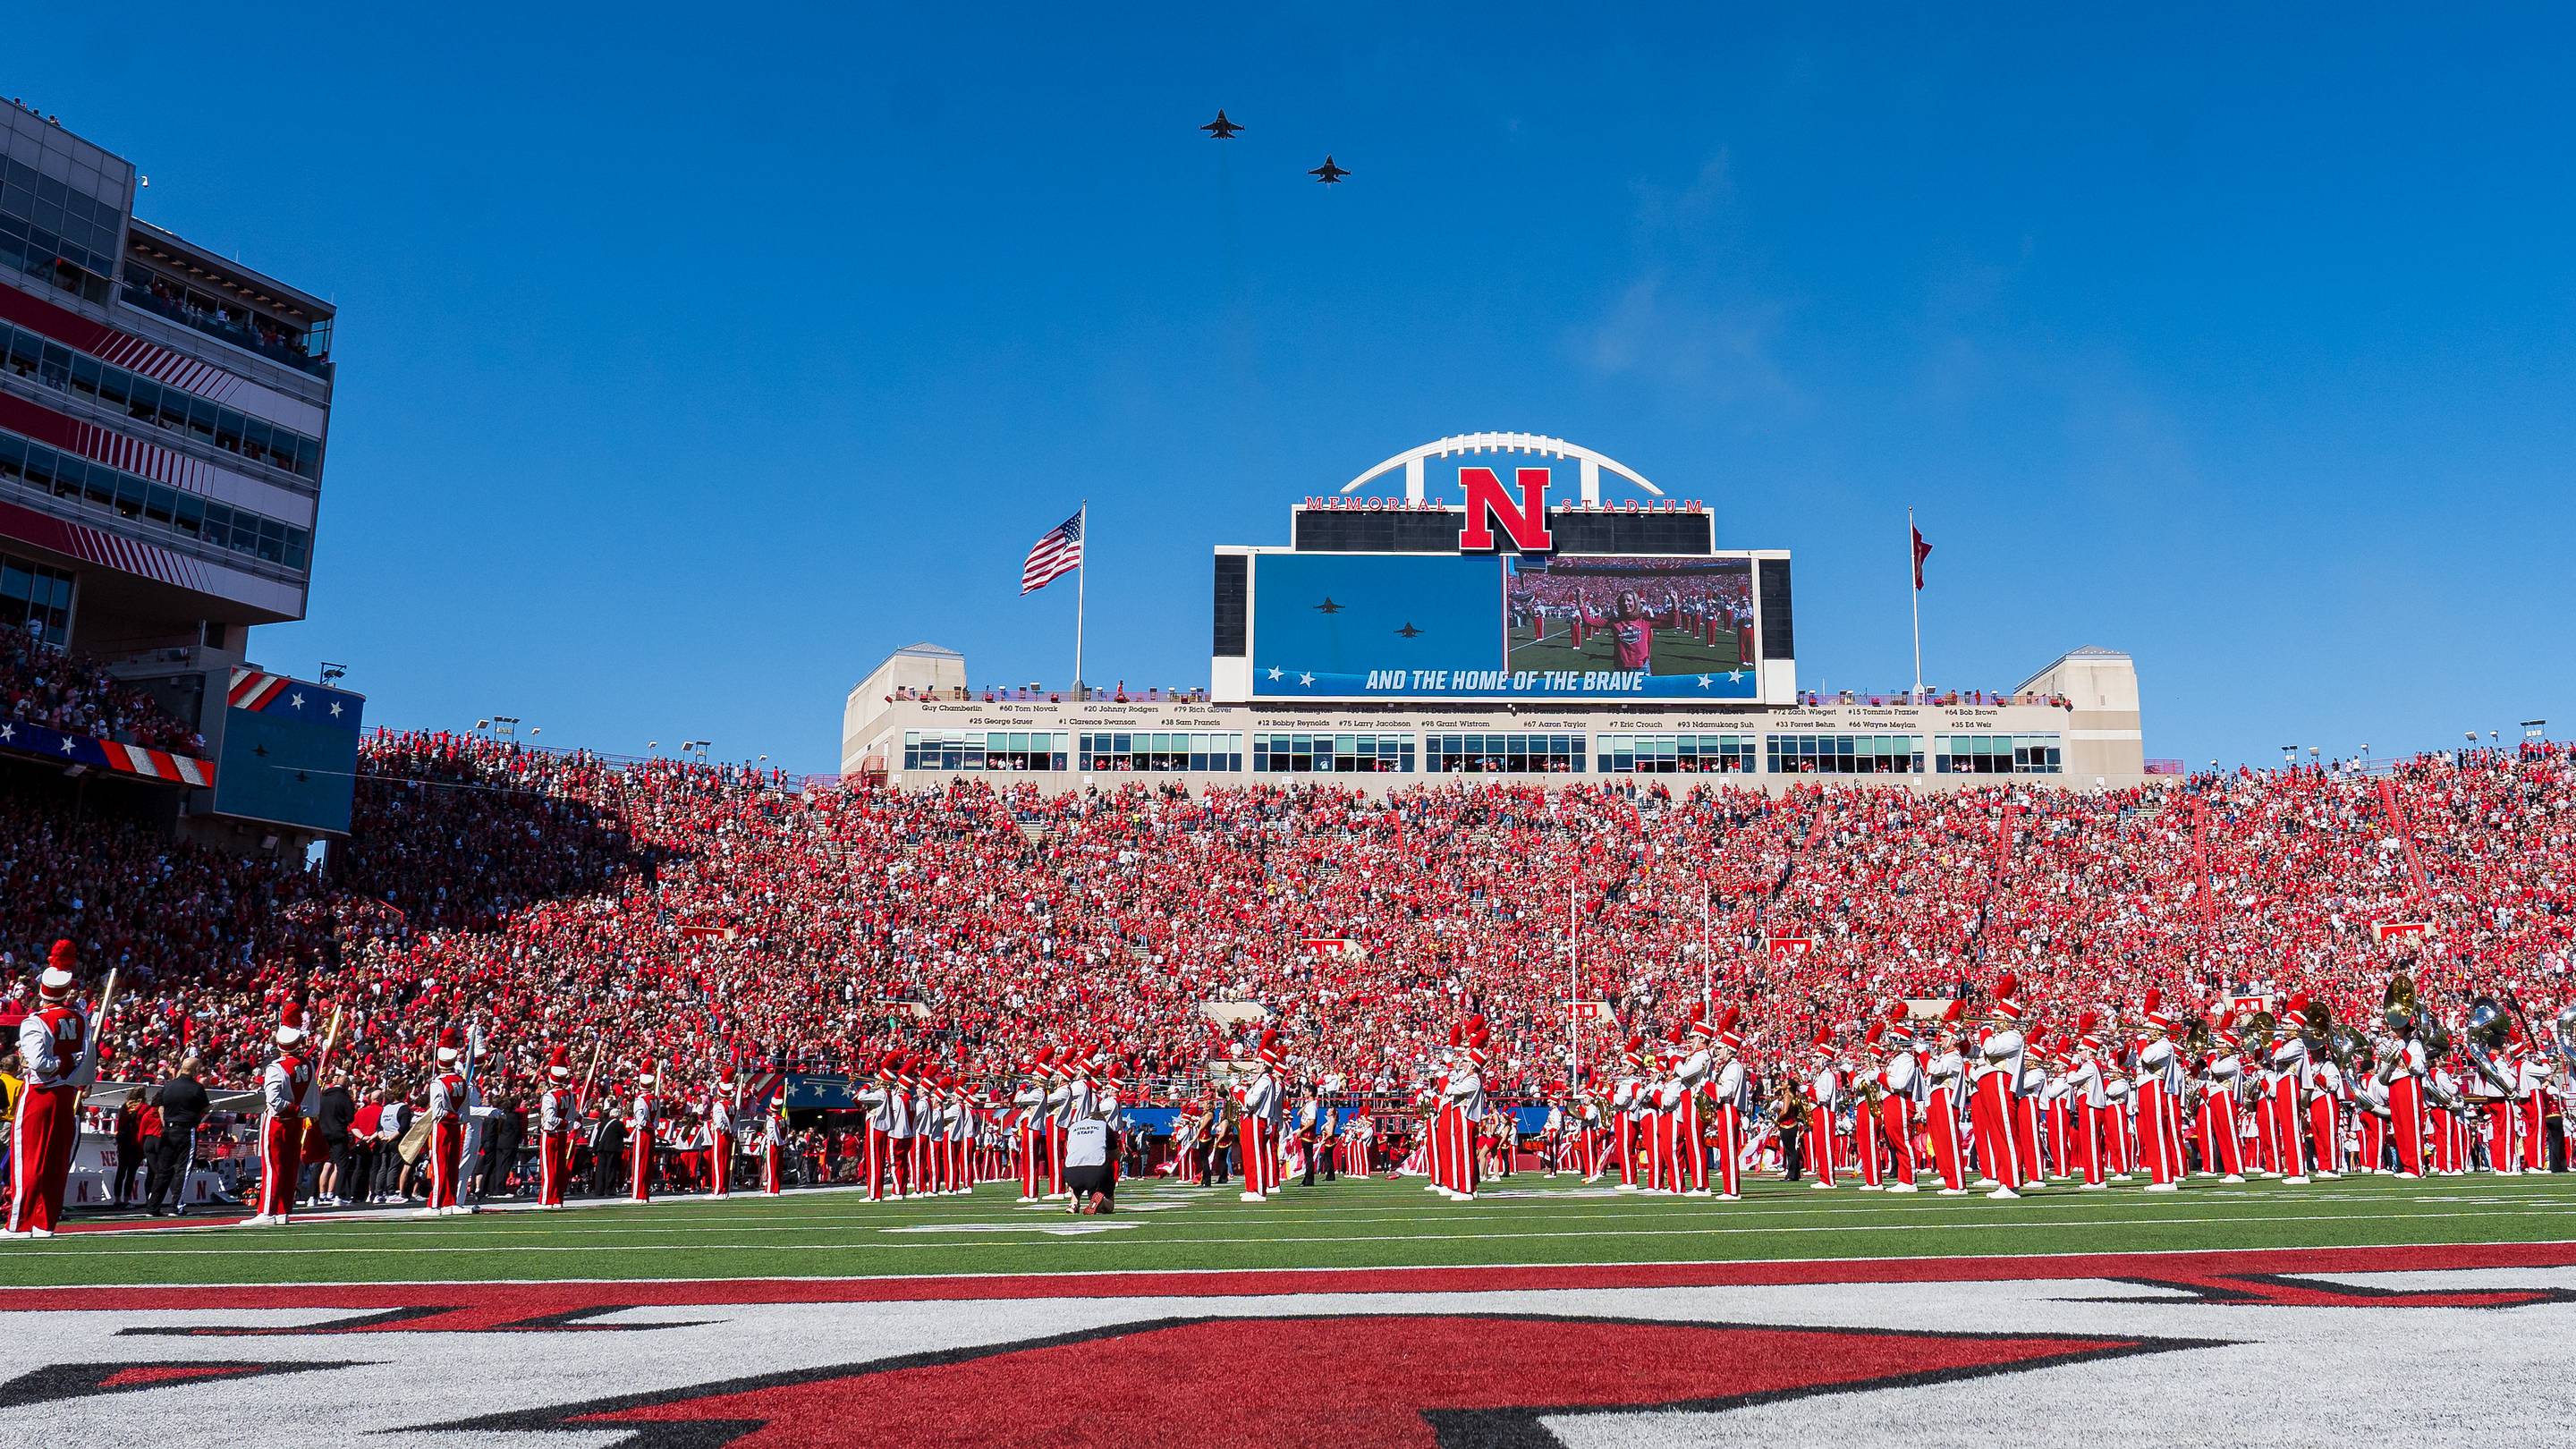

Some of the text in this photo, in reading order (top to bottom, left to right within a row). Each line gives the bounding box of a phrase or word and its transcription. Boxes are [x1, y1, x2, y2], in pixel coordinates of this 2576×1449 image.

[1305, 496, 1703, 513] MEMORIAL STADIUM
[1458, 467, 1552, 551] N
[1365, 670, 1644, 691] AND THE HOME OF THE BRAVE
[922, 705, 937, 713] Guy
[1098, 706, 1127, 714] Johnny
[1128, 706, 1159, 714] Rodgers
[1808, 708, 1836, 716] Wiegert
[1353, 720, 1374, 728] Larry
[1692, 721, 1739, 729] Ndamukong
[1584, 1006, 1593, 1016] N
[2250, 1001, 2260, 1011] N
[58, 1018, 77, 1040] N
[294, 1064, 309, 1082] N
[452, 1081, 463, 1097] N
[560, 1095, 570, 1109] N
[77, 1181, 89, 1202] N
[196, 1181, 207, 1200] N
